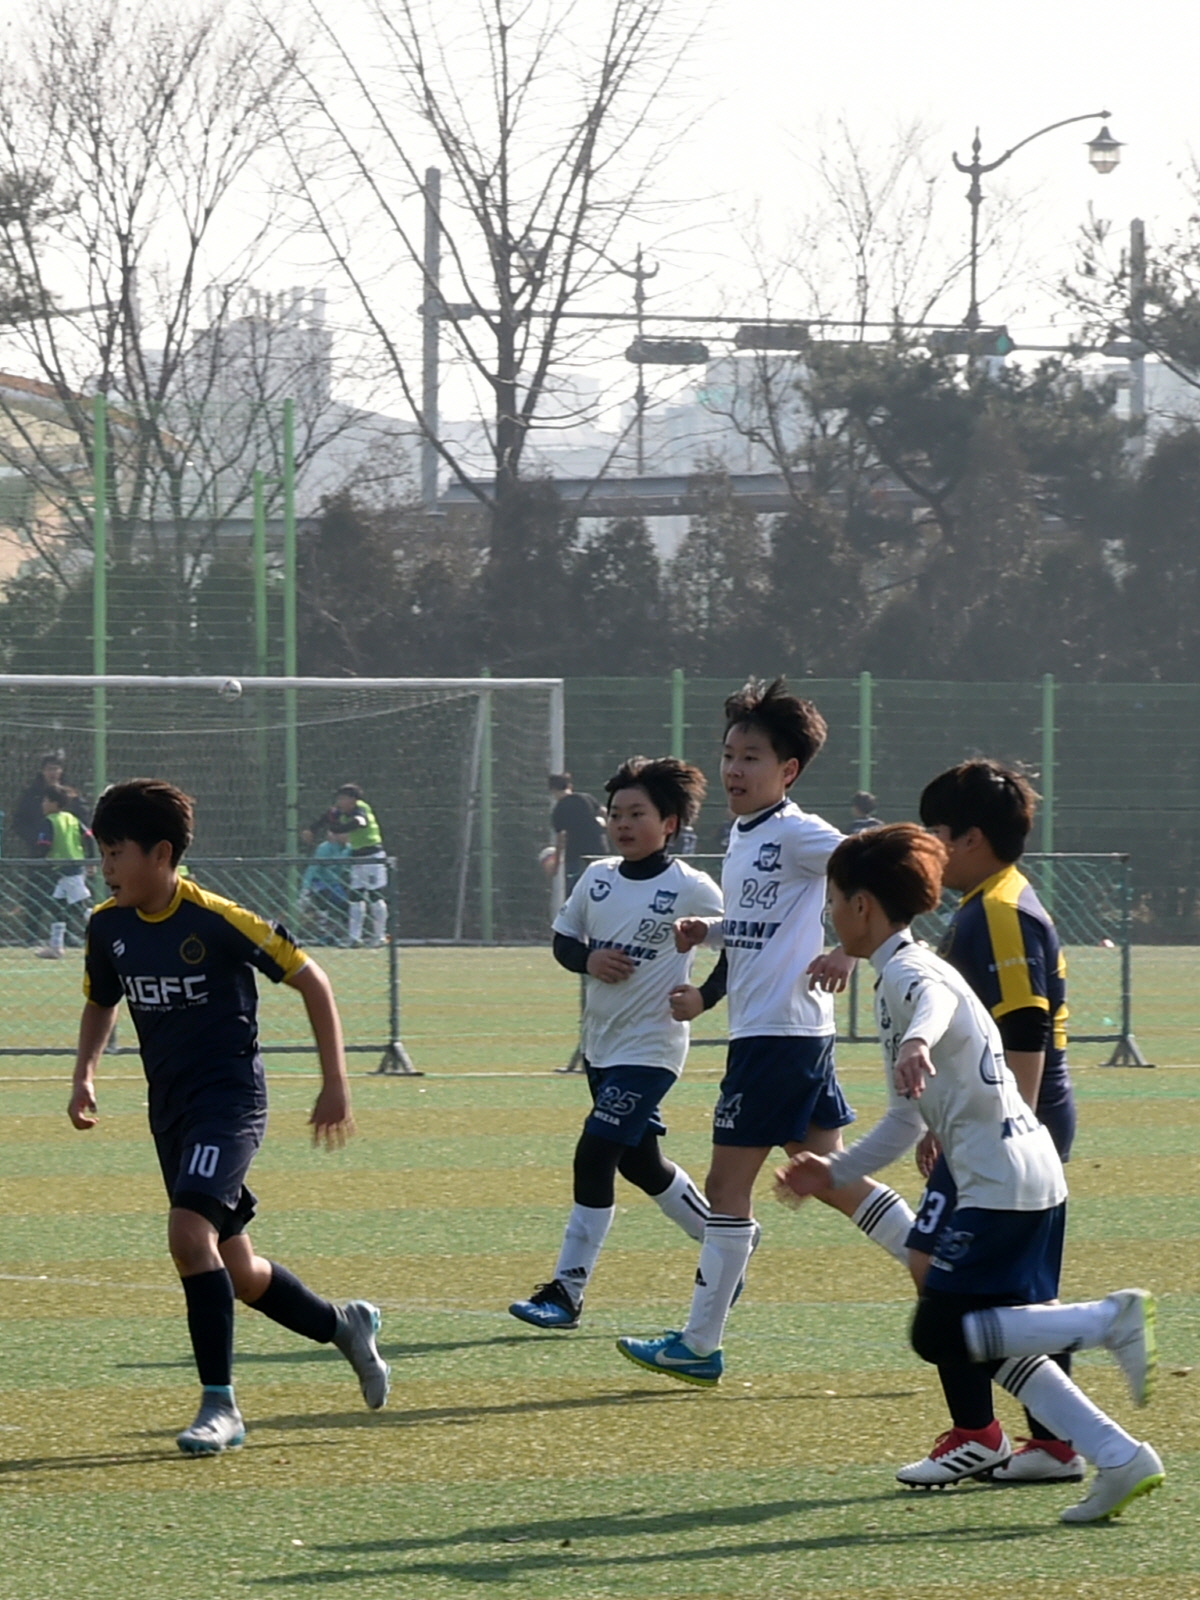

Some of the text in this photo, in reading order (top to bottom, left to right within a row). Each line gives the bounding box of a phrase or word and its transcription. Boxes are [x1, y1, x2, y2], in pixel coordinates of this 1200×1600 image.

[739, 878, 780, 910] 24
[633, 918, 673, 944] 25
[597, 1086, 642, 1116] 25
[188, 1143, 220, 1178] 10
[917, 1187, 946, 1234] 3
